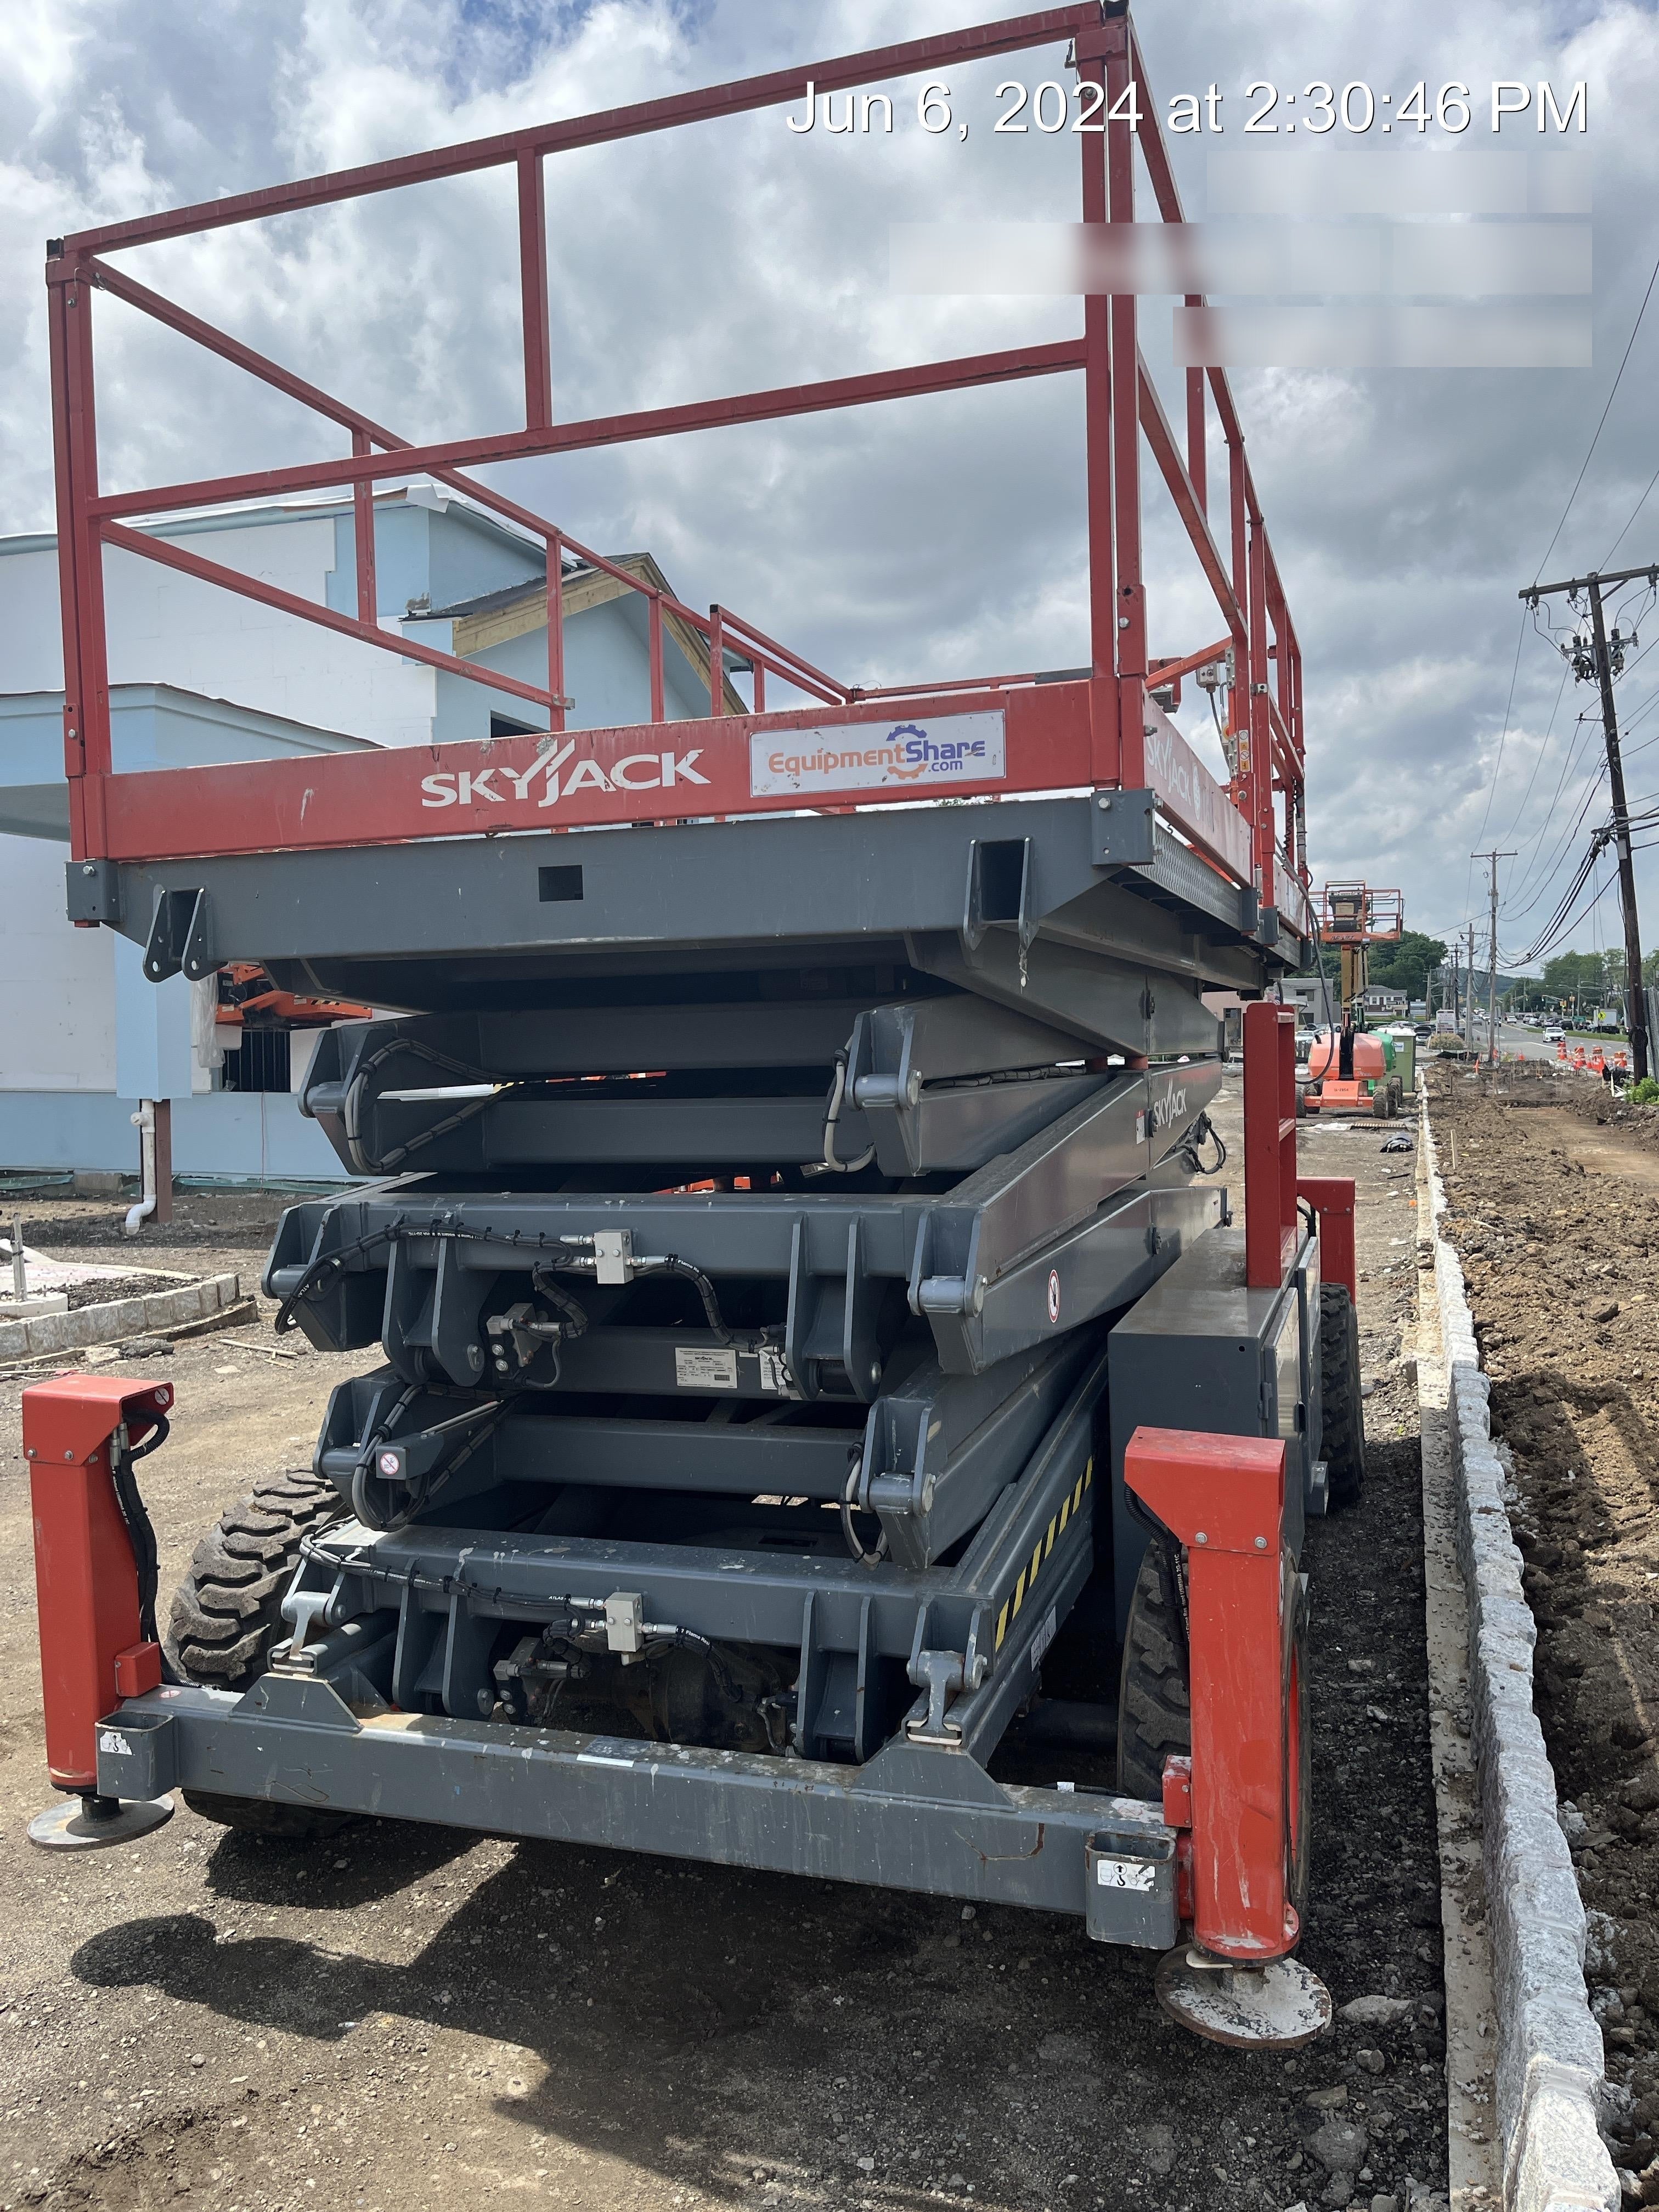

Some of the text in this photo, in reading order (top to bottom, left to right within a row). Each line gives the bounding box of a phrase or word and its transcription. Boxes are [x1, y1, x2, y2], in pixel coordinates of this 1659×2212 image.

[421, 738, 712, 808] SKYJACK
[768, 741, 985, 776] EquipmentShare
[928, 760, 963, 772] .com
[1146, 732, 1192, 807] SKYJACK
[1153, 1077, 1188, 1129] SKYJACK
